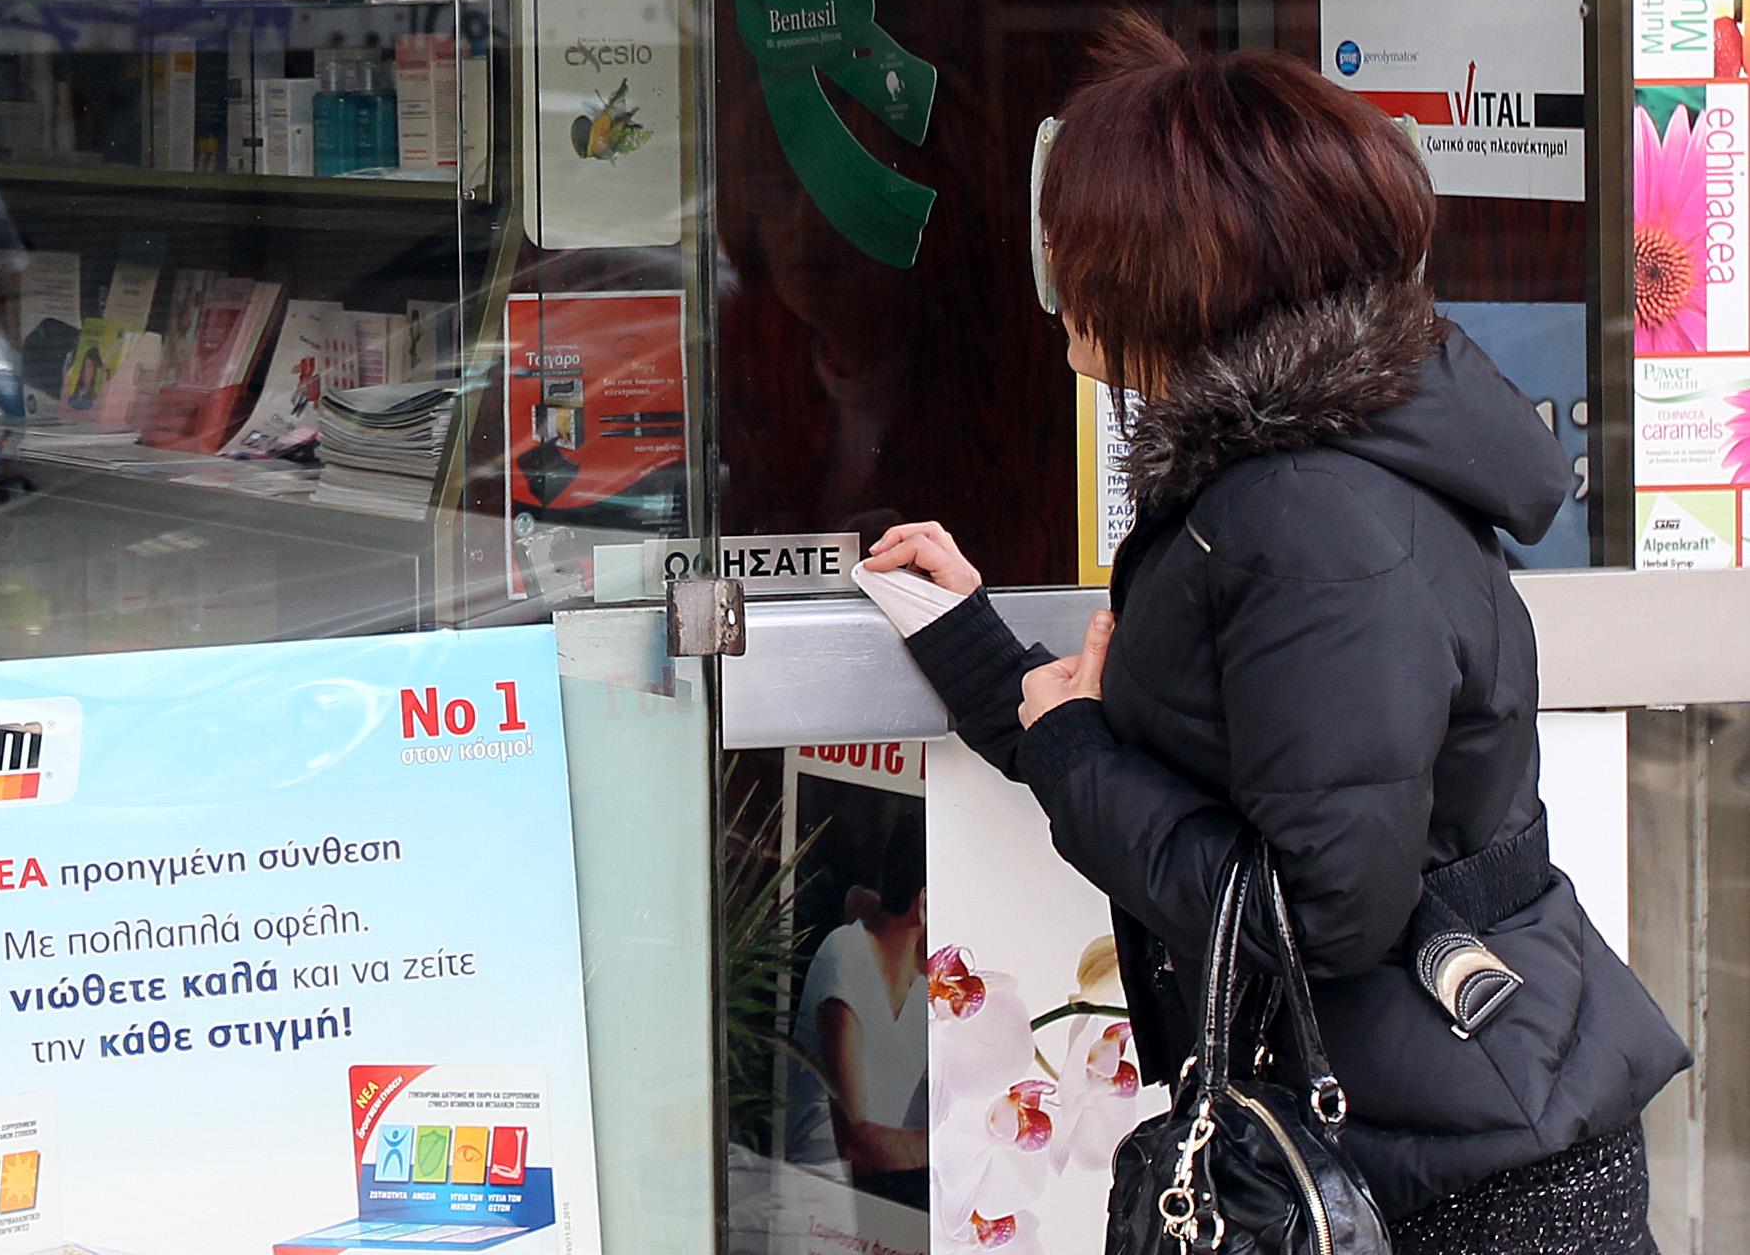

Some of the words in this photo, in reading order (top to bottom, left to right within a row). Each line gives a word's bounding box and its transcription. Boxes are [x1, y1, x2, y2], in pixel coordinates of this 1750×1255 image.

[769, 0, 838, 34] Bentasil
[1455, 60, 1531, 127] VITAL
[1426, 135, 1464, 156] ζωτικό
[1467, 140, 1487, 156] σας
[1490, 138, 1568, 158] πλεονέκτημα!
[1705, 106, 1746, 285] echinacea
[1659, 379, 1698, 391] HEALTH
[1642, 418, 1723, 441] caramels
[1658, 410, 1704, 421] ECHINACEA
[1653, 519, 1681, 530] Salus
[1643, 559, 1668, 569] Herbal
[1670, 559, 1694, 570] Syrup
[400, 687, 476, 740] No
[494, 680, 528, 734] 1
[400, 740, 454, 766] στον
[458, 734, 536, 765] κόσμο!
[59, 847, 247, 890] προηγμένη
[257, 833, 403, 872] σύνθεση
[4, 929, 56, 961] Με
[67, 913, 242, 956] πολλαπλά
[253, 904, 371, 944] οφέλη.
[9, 972, 168, 1014] νιώθετε
[181, 960, 280, 1001] καλά
[292, 960, 341, 991] και
[352, 958, 391, 987] να
[402, 947, 477, 983] ζείτε
[31, 1036, 86, 1065] την
[99, 1017, 194, 1059] κάθε
[206, 1005, 354, 1054] στιγμή!
[356, 1081, 380, 1109] ΝΕΑ
